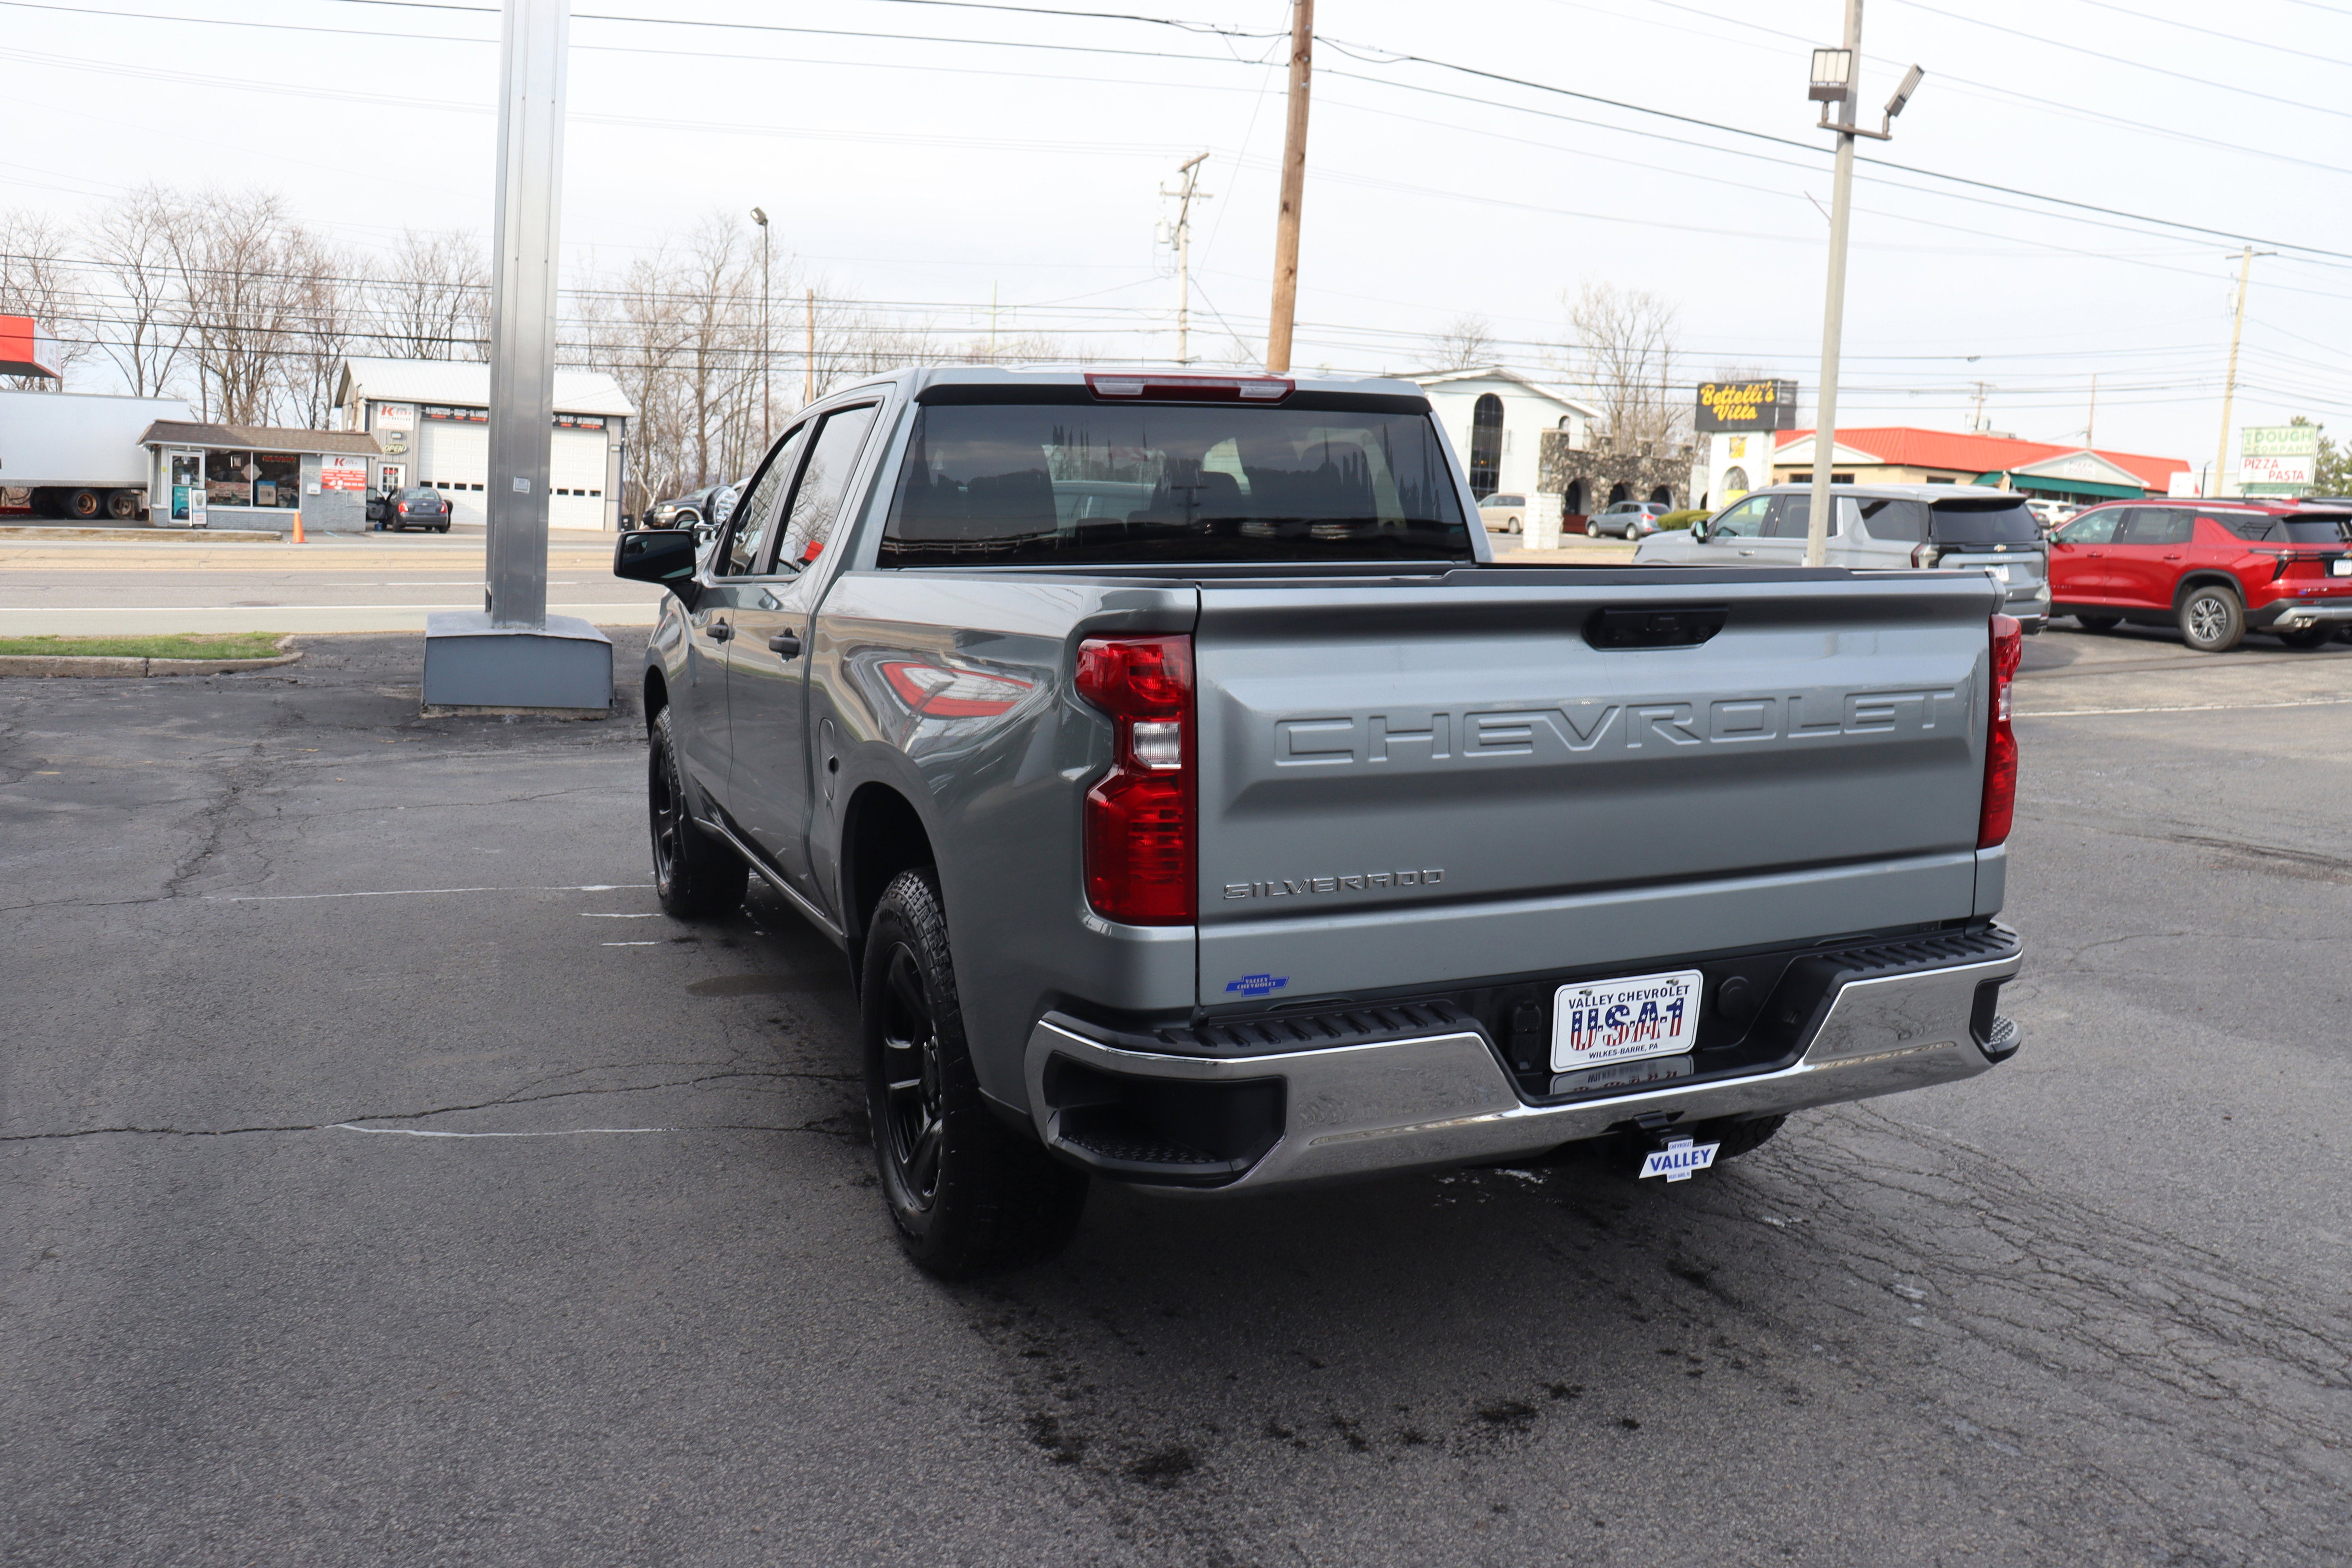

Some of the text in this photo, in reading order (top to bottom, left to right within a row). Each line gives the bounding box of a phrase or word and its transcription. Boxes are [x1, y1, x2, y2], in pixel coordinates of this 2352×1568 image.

[1700, 381, 1775, 406] Bettelli's
[1713, 403, 1758, 421] Villa
[2255, 430, 2313, 443] DOUGH
[2254, 445, 2311, 453] COMPANY
[2244, 458, 2278, 470] PIZZA
[2269, 470, 2304, 482] PASTA
[1275, 688, 1955, 767] CHEVROLET
[1224, 869, 1445, 899] SILVERADO
[1237, 981, 1276, 989] CHEVROLET
[1569, 985, 1690, 1009] VALLEY CHEVROLET
[1589, 1045, 1647, 1059] WILKES-BARRE,
[1669, 1141, 1693, 1150] CHEVROLET
[1650, 1149, 1712, 1172] VALLEY
